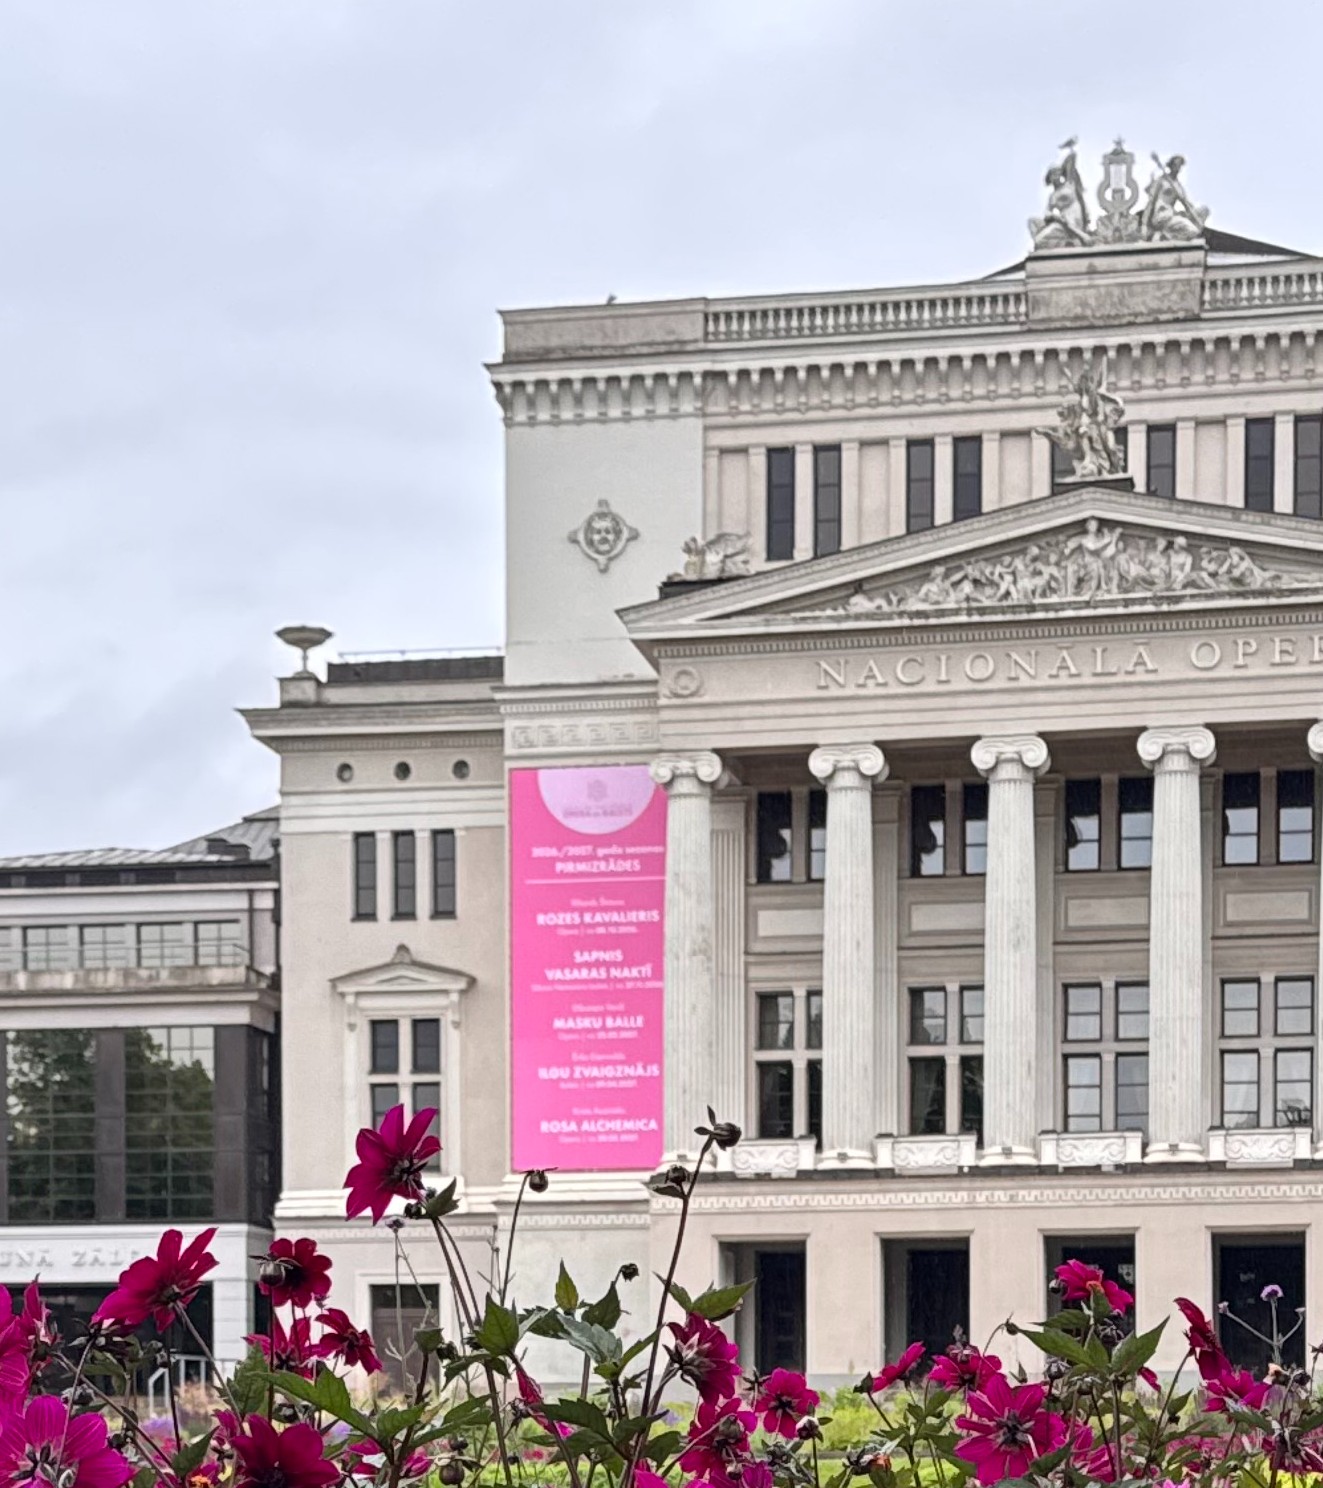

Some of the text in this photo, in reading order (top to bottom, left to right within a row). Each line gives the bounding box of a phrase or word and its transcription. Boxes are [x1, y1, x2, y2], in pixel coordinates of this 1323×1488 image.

[816, 640, 1158, 690] NACIONĀLĀ
[536, 909, 660, 926] ROZES KAVALIERIS
[573, 949, 623, 964] SAPNIS
[544, 967, 607, 981] VASARAS
[553, 1014, 644, 1030] MASKU BALLE
[540, 1118, 659, 1134] ROSA ALCHEMICA
